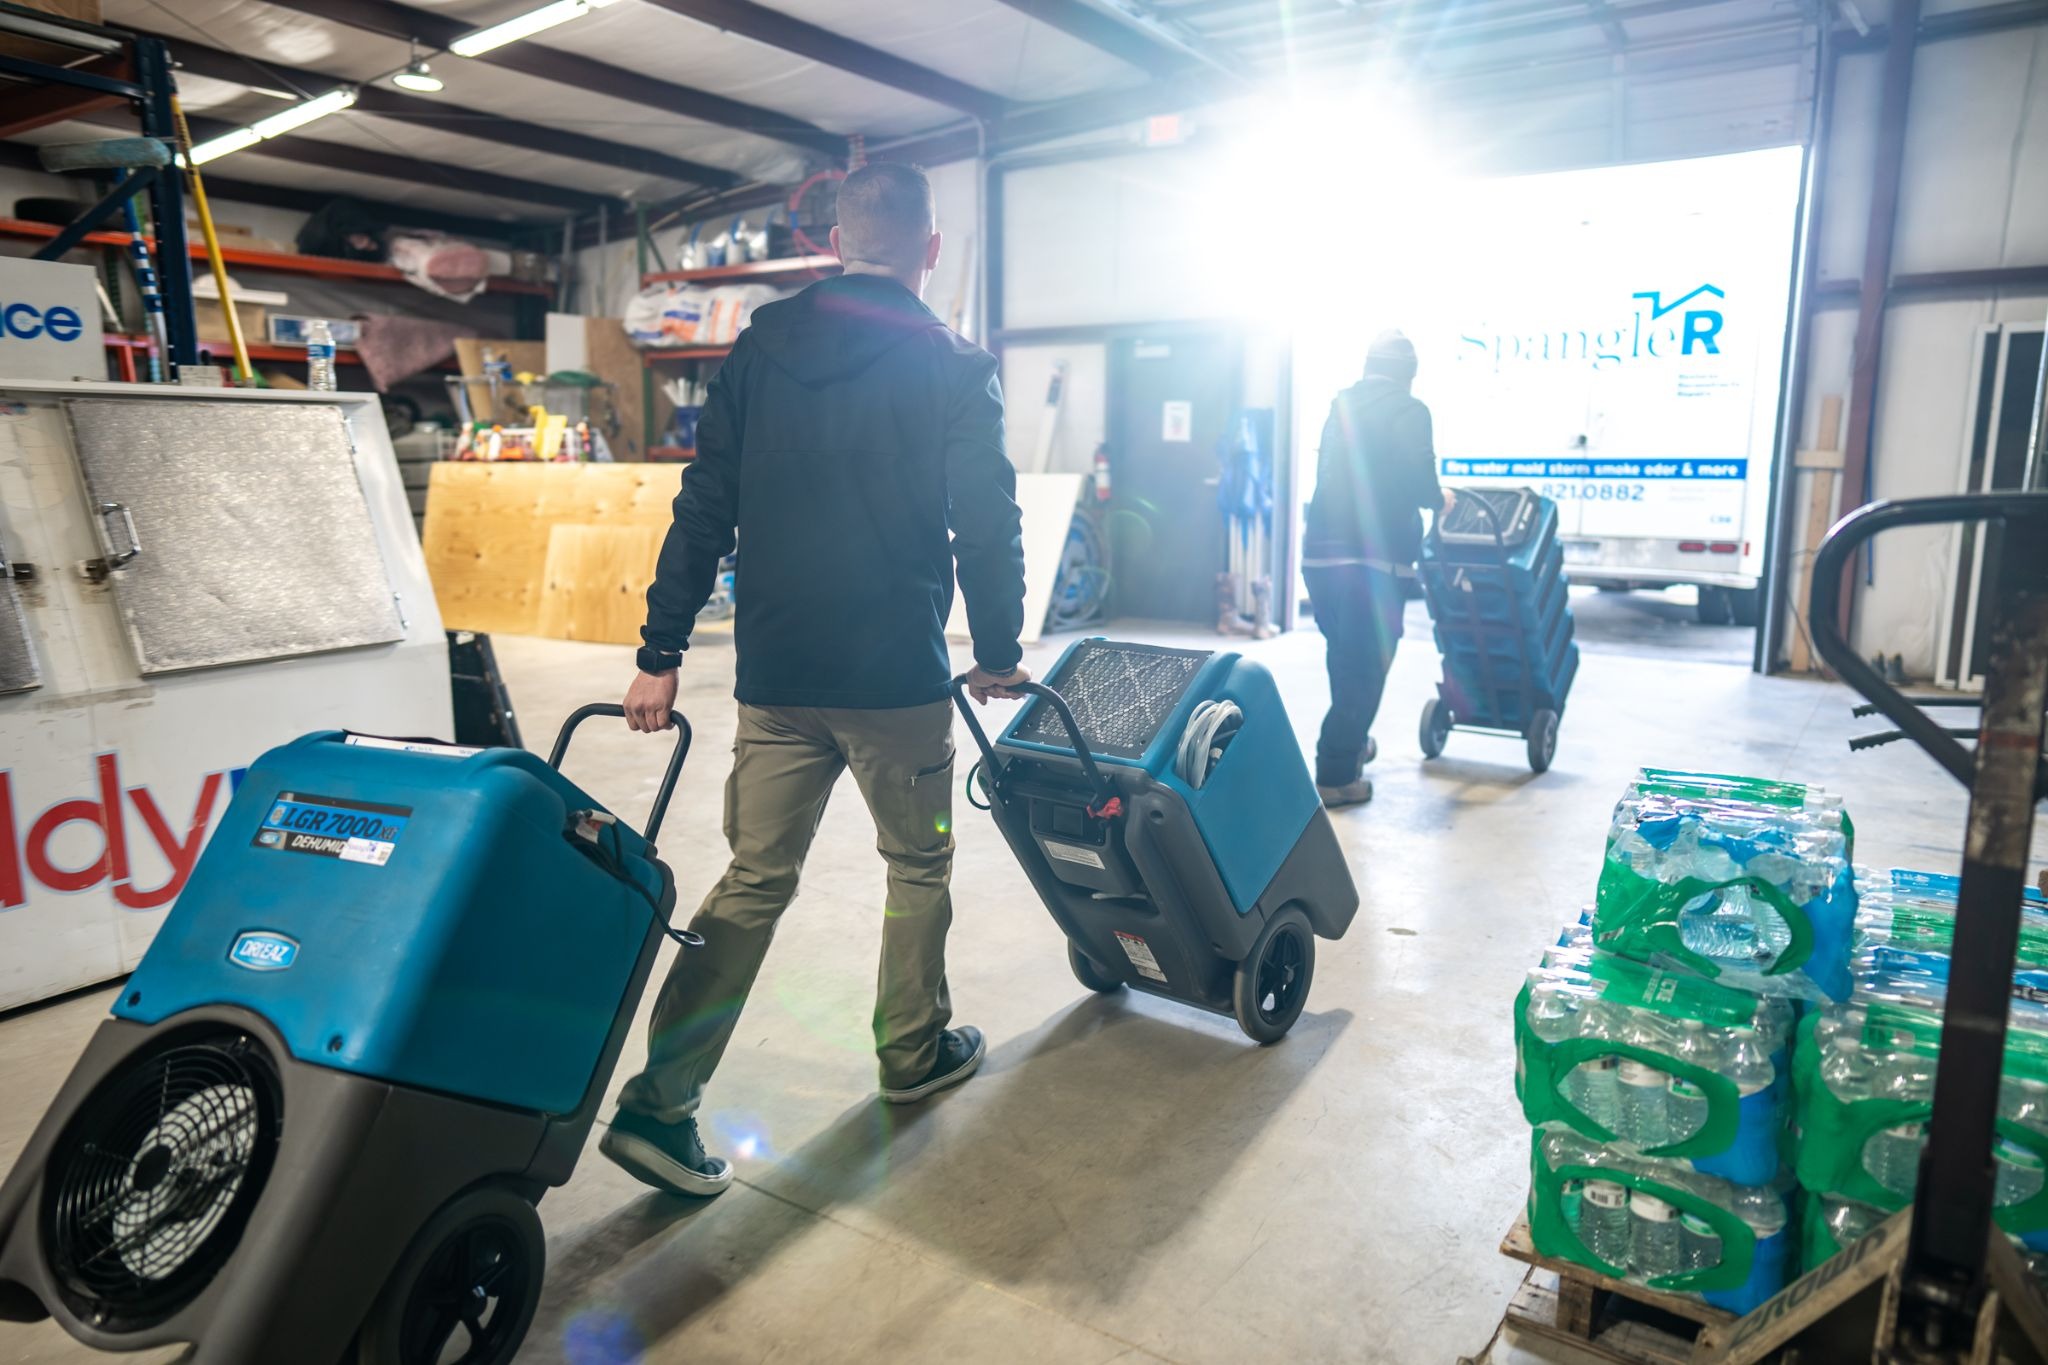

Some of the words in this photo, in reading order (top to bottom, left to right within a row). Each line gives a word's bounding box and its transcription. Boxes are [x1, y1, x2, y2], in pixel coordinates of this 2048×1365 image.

[1594, 462, 1640, 476] smoke
[1643, 463, 1678, 476] odor
[1681, 462, 1694, 477] &
[1697, 464, 1738, 477] more
[0, 753, 224, 908] dy
[282, 807, 328, 831] LGR
